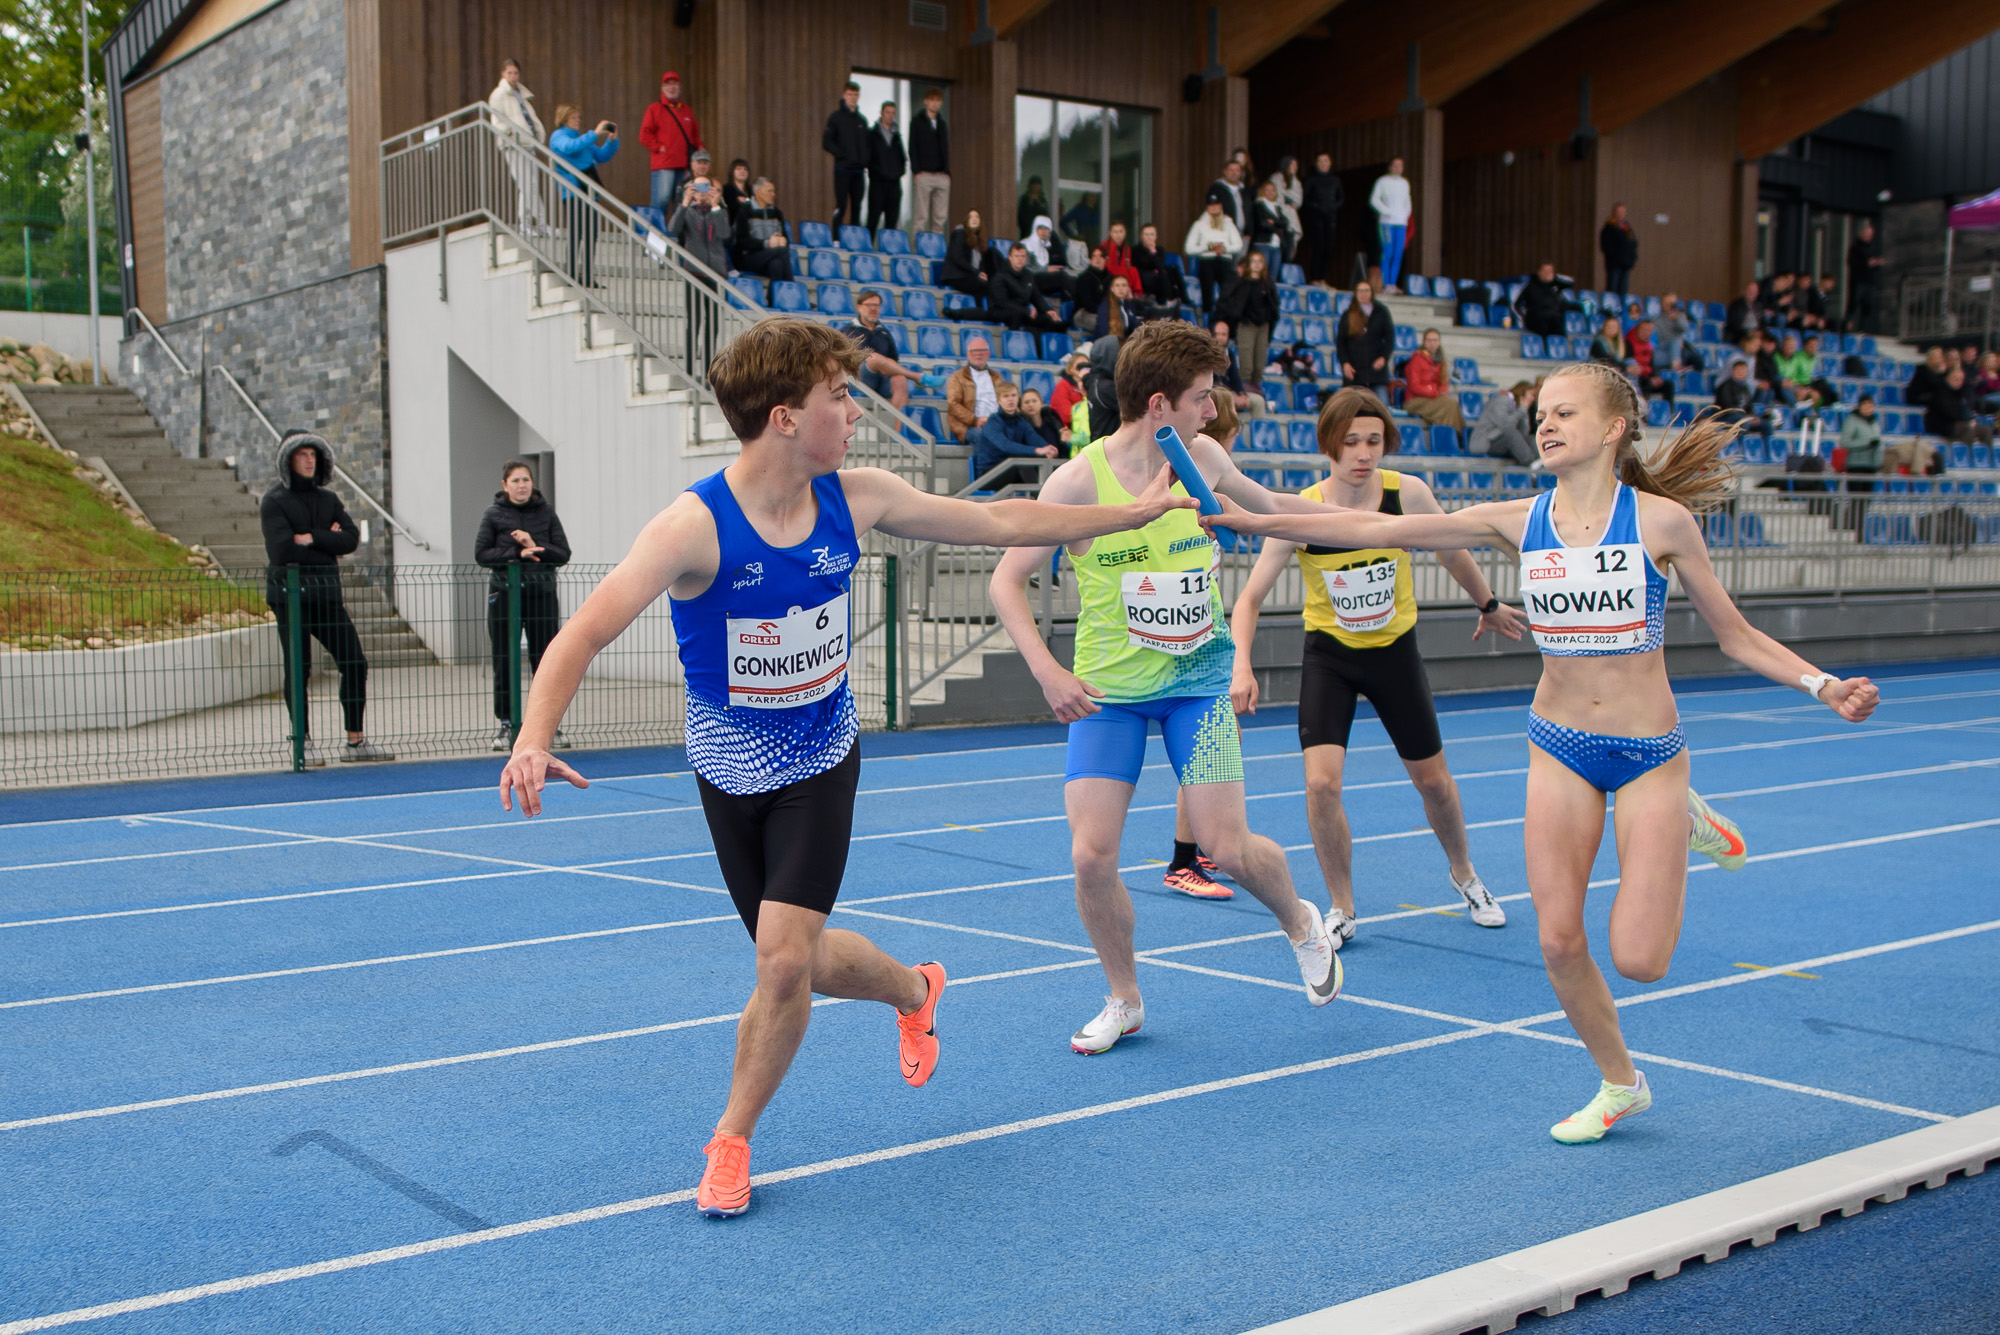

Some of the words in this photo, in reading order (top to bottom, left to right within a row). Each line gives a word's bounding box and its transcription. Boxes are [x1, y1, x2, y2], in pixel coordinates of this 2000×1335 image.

[1594, 549, 1628, 573] 12
[1365, 562, 1395, 583] 135
[1530, 568, 1564, 579] ORLEN
[1530, 588, 1635, 614] NOWAK
[815, 607, 829, 630] 6
[741, 635, 779, 645] ORLEN
[1140, 637, 1179, 650] KARPACZ
[1543, 635, 1591, 644] KARPACZ
[1593, 635, 1618, 644] 2022
[733, 633, 844, 677] GONKIEWICZ
[747, 693, 800, 704] KARPACZ
[803, 685, 826, 700] 2022
